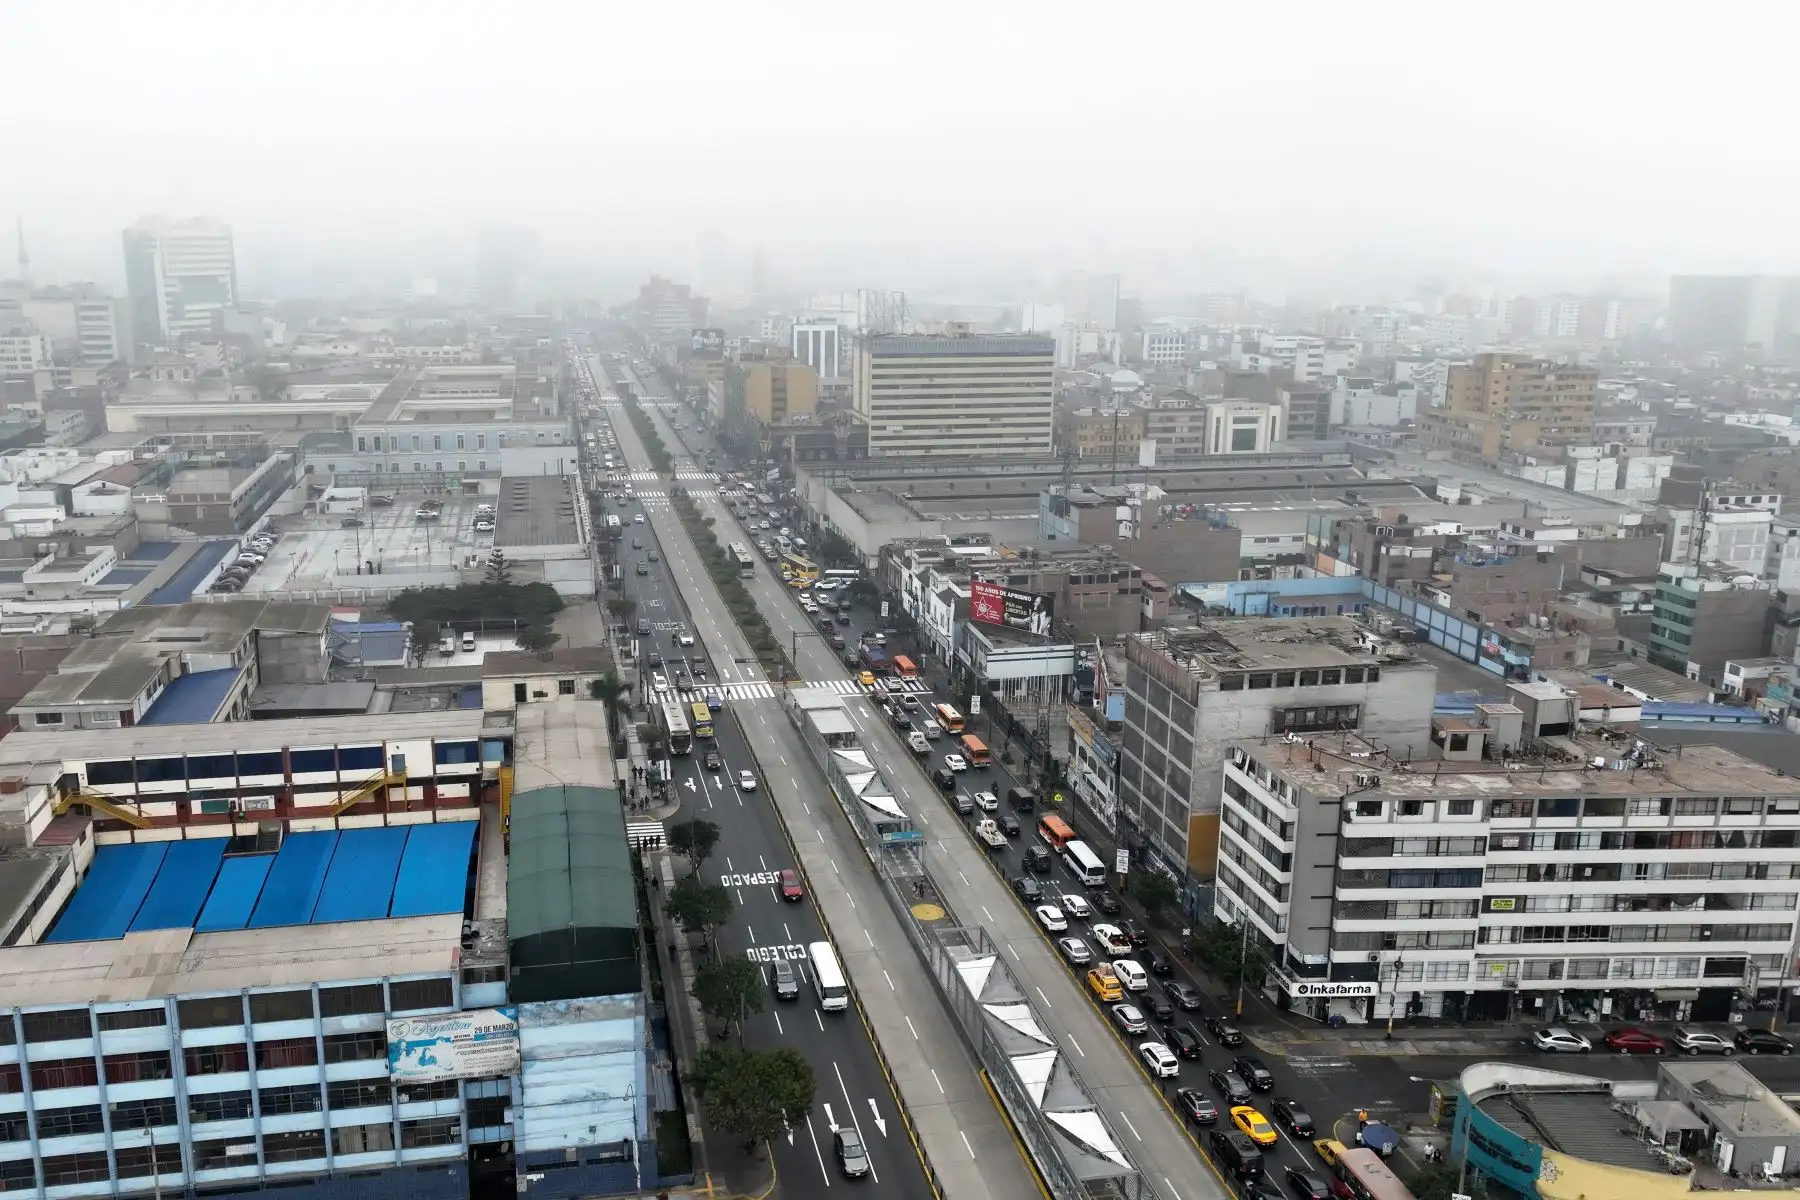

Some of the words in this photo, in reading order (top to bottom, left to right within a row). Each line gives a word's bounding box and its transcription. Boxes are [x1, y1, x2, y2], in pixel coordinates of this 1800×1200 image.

[1007, 592, 1032, 602] APRISMO
[720, 870, 780, 887] DESPACIO
[746, 944, 807, 962] COLEGIO
[1310, 984, 1371, 995] Inkafarma
[474, 1026, 483, 1034] 29
[483, 1024, 493, 1033] DE
[493, 1022, 514, 1033] MARZO
